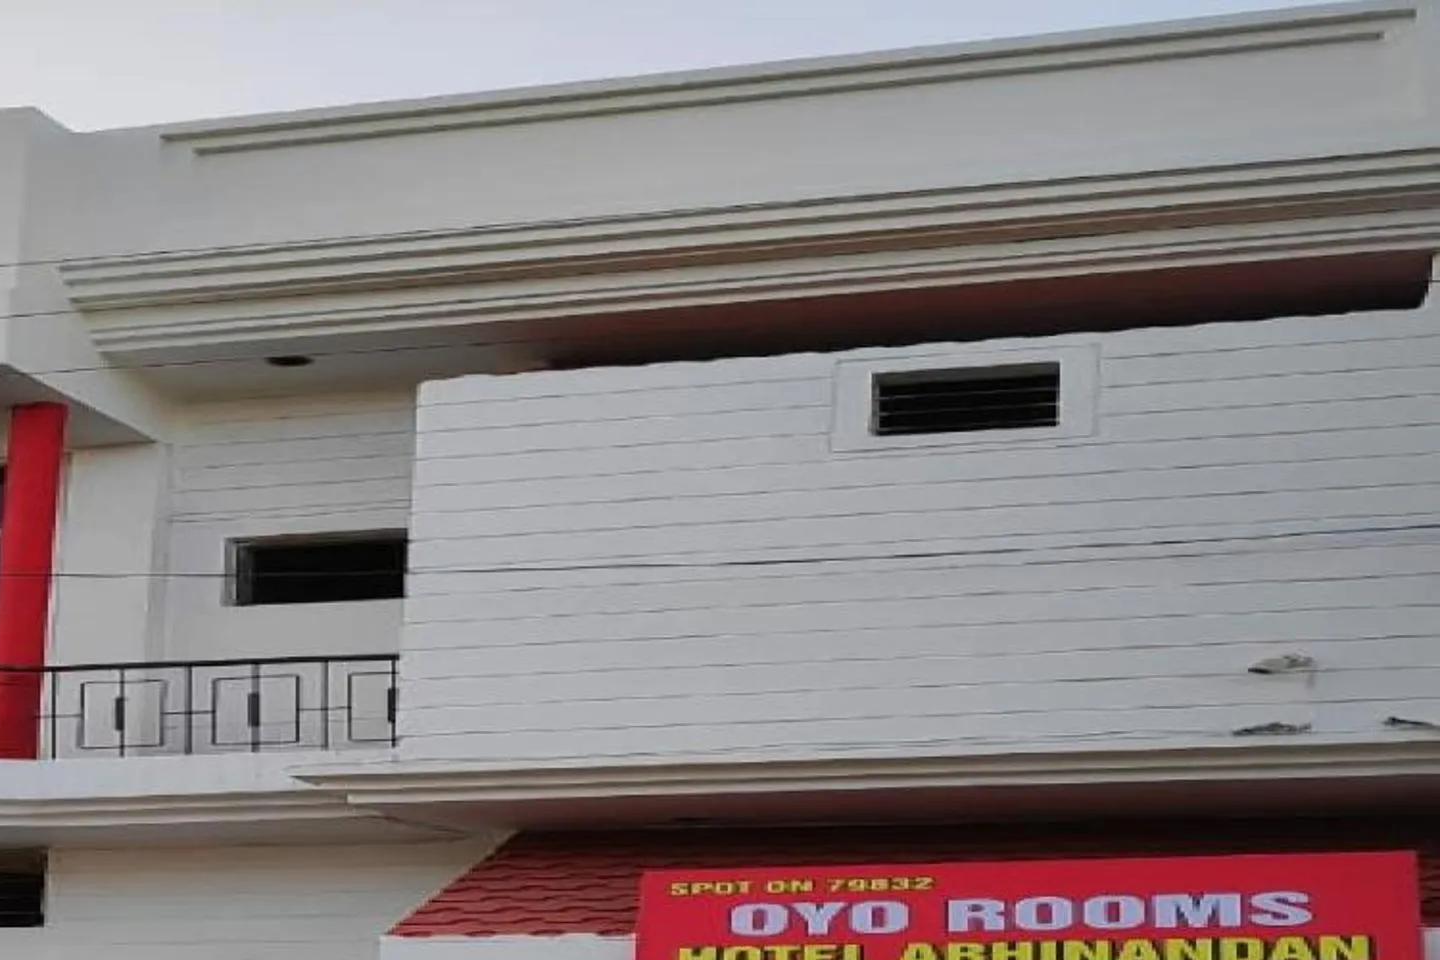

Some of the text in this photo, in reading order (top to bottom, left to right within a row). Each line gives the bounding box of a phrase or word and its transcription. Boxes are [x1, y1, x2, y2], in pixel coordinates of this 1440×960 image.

[670, 876, 935, 895] SPOT ON 79832
[729, 891, 1313, 936] OYO ROOMS
